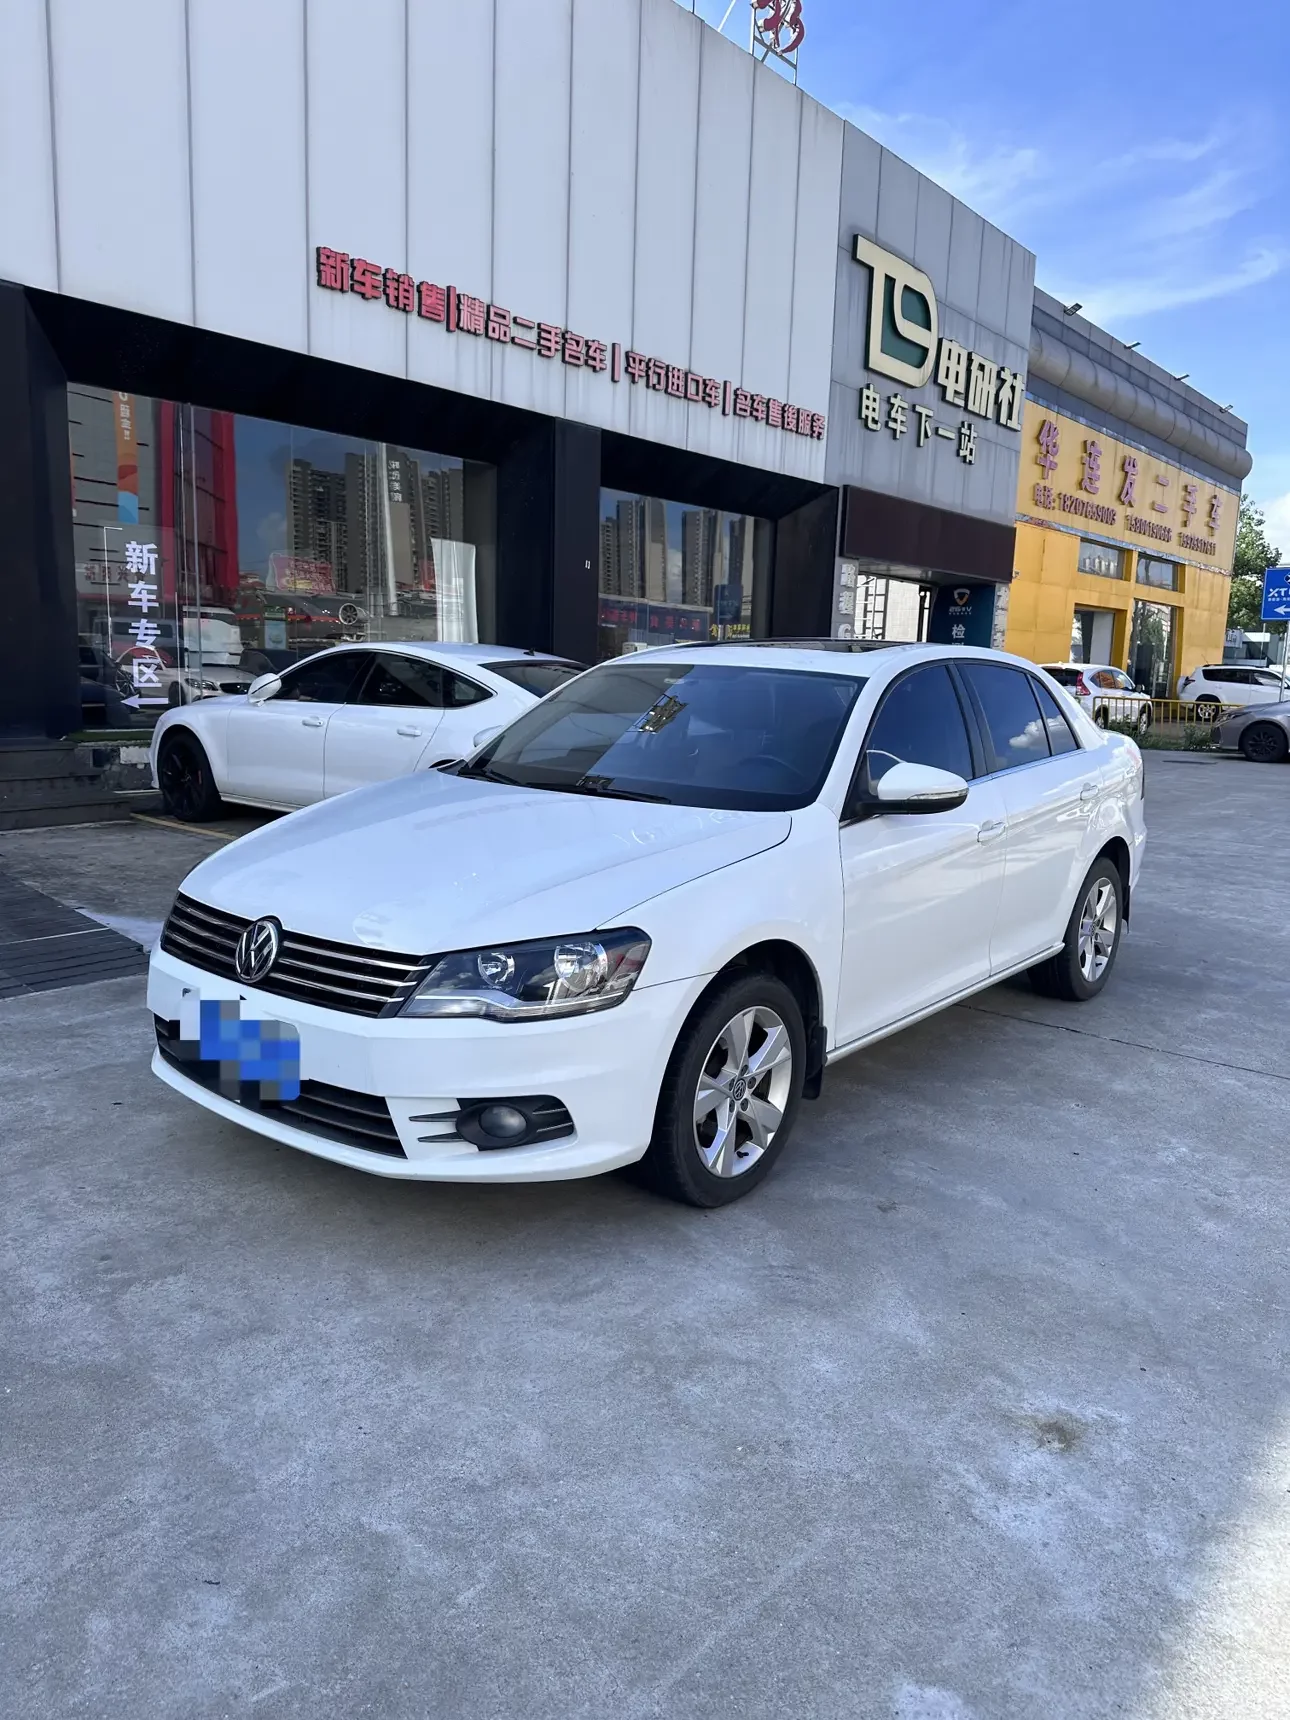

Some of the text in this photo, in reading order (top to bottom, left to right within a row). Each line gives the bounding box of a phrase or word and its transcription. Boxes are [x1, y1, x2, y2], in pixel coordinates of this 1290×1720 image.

[316, 246, 446, 323] 新车销售
[457, 293, 607, 373] 精品二手名车
[625, 350, 721, 408] 平行进口车
[859, 383, 978, 465] 电车下一站
[935, 337, 1025, 432] 电研社
[125, 540, 162, 688] 新车专区
[1268, 587, 1290, 597] XT
